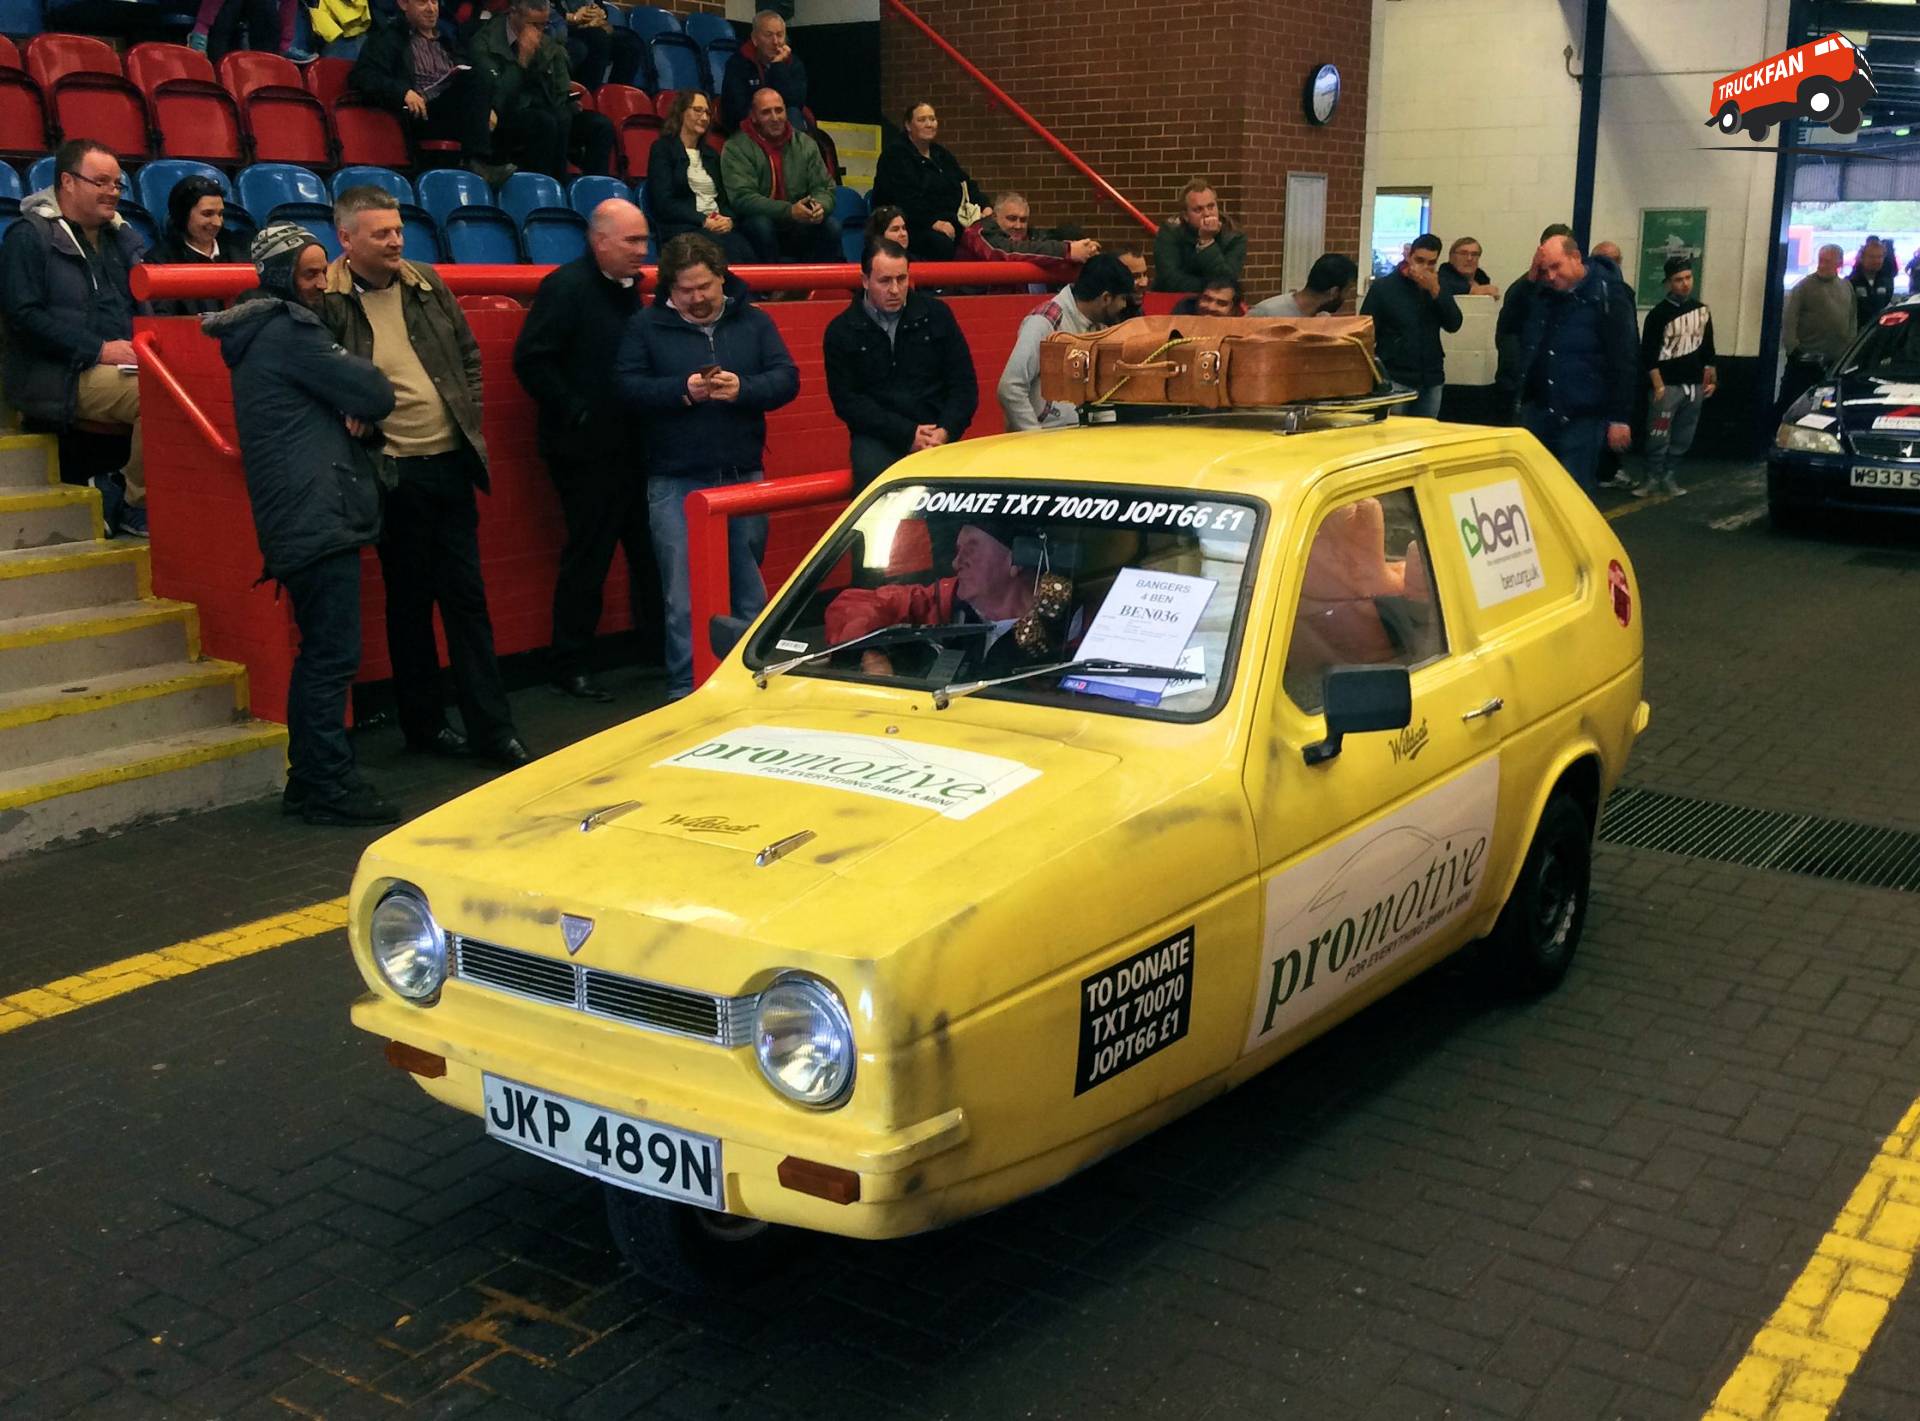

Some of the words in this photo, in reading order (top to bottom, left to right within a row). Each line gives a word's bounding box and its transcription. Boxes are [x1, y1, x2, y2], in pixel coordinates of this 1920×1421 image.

[1855, 469, 1903, 485] W933
[911, 491, 1002, 514] DONATE
[1001, 494, 1051, 516] TXT
[1048, 495, 1120, 521] 70070
[1118, 501, 1213, 528] JOPT66
[1211, 508, 1246, 532] £1
[1471, 497, 1530, 555] ben
[1120, 604, 1180, 623] BEN036
[1135, 579, 1192, 593] BANGERS
[1140, 593, 1148, 601] 4
[1149, 594, 1174, 604] BEN
[673, 741, 988, 801] promotive
[760, 766, 789, 775] FOR
[789, 769, 873, 789] EVERYTHING
[870, 785, 908, 796] BMW
[920, 795, 955, 807] MINI
[1258, 836, 1487, 1037] promotive
[1087, 976, 1113, 1012] TO
[1117, 936, 1190, 999] DONATE
[1091, 1002, 1130, 1045] TXT
[1134, 973, 1185, 1024] 70070
[1089, 1020, 1157, 1082] JOPT66
[1160, 1008, 1180, 1042] £1
[490, 1086, 571, 1149] JKP
[585, 1115, 713, 1197] 489N
